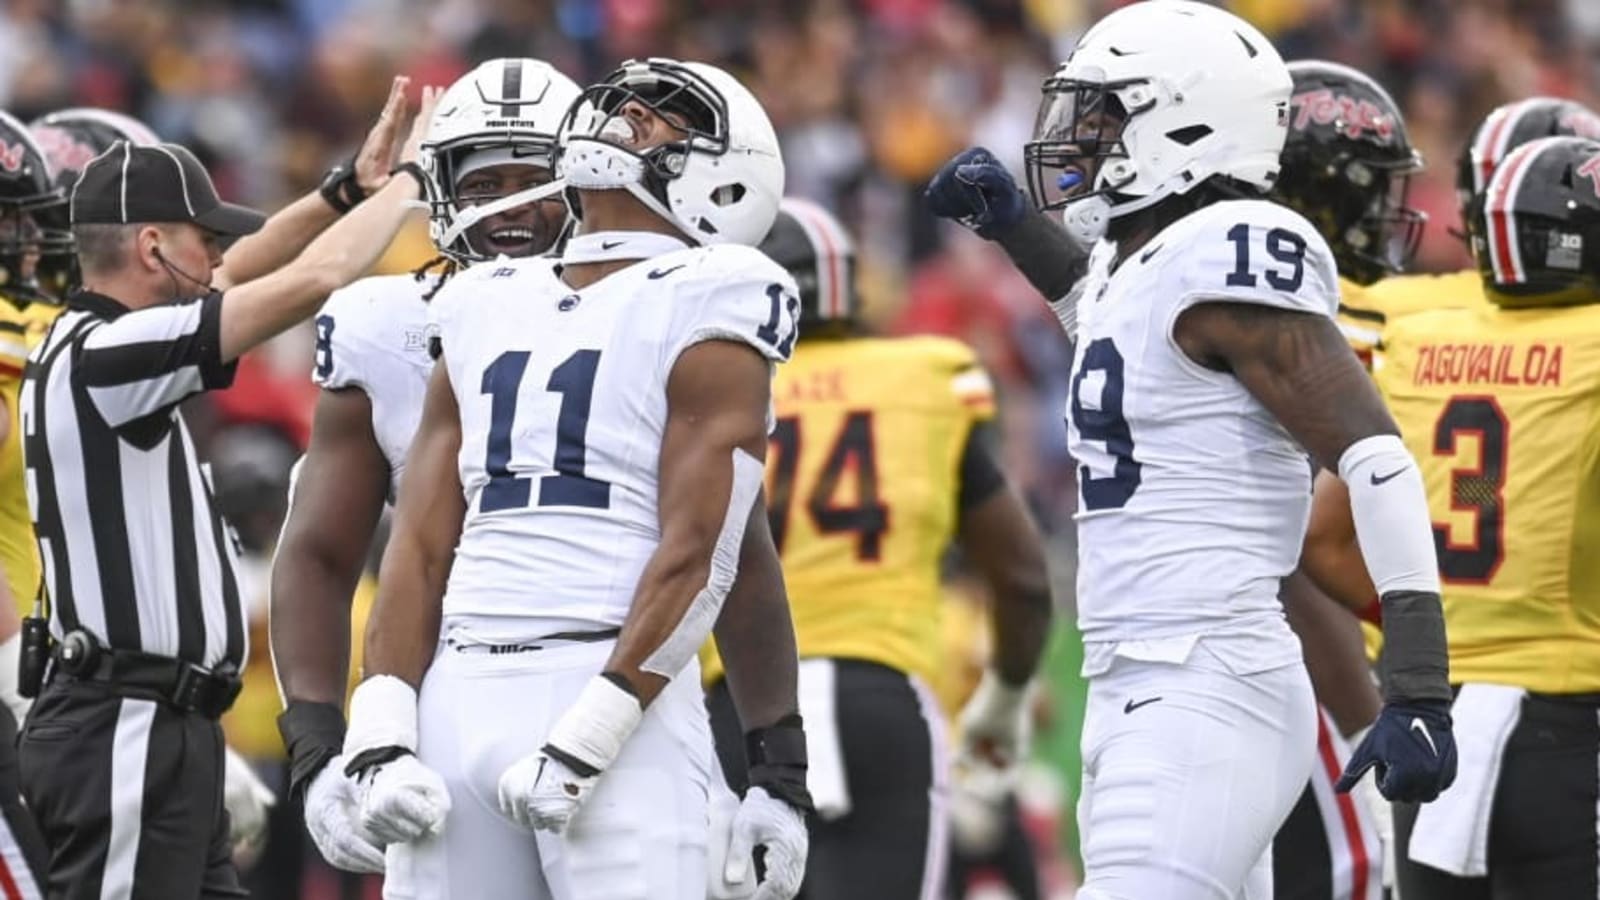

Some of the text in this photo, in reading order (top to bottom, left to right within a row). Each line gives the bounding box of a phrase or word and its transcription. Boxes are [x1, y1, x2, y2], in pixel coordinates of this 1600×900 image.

[1226, 223, 1307, 293] 19
[757, 283, 799, 359] 11
[1413, 344, 1563, 387] TAGOVAILOA
[479, 349, 611, 513] 11
[1070, 337, 1142, 511] 9
[1432, 394, 1511, 585] 3
